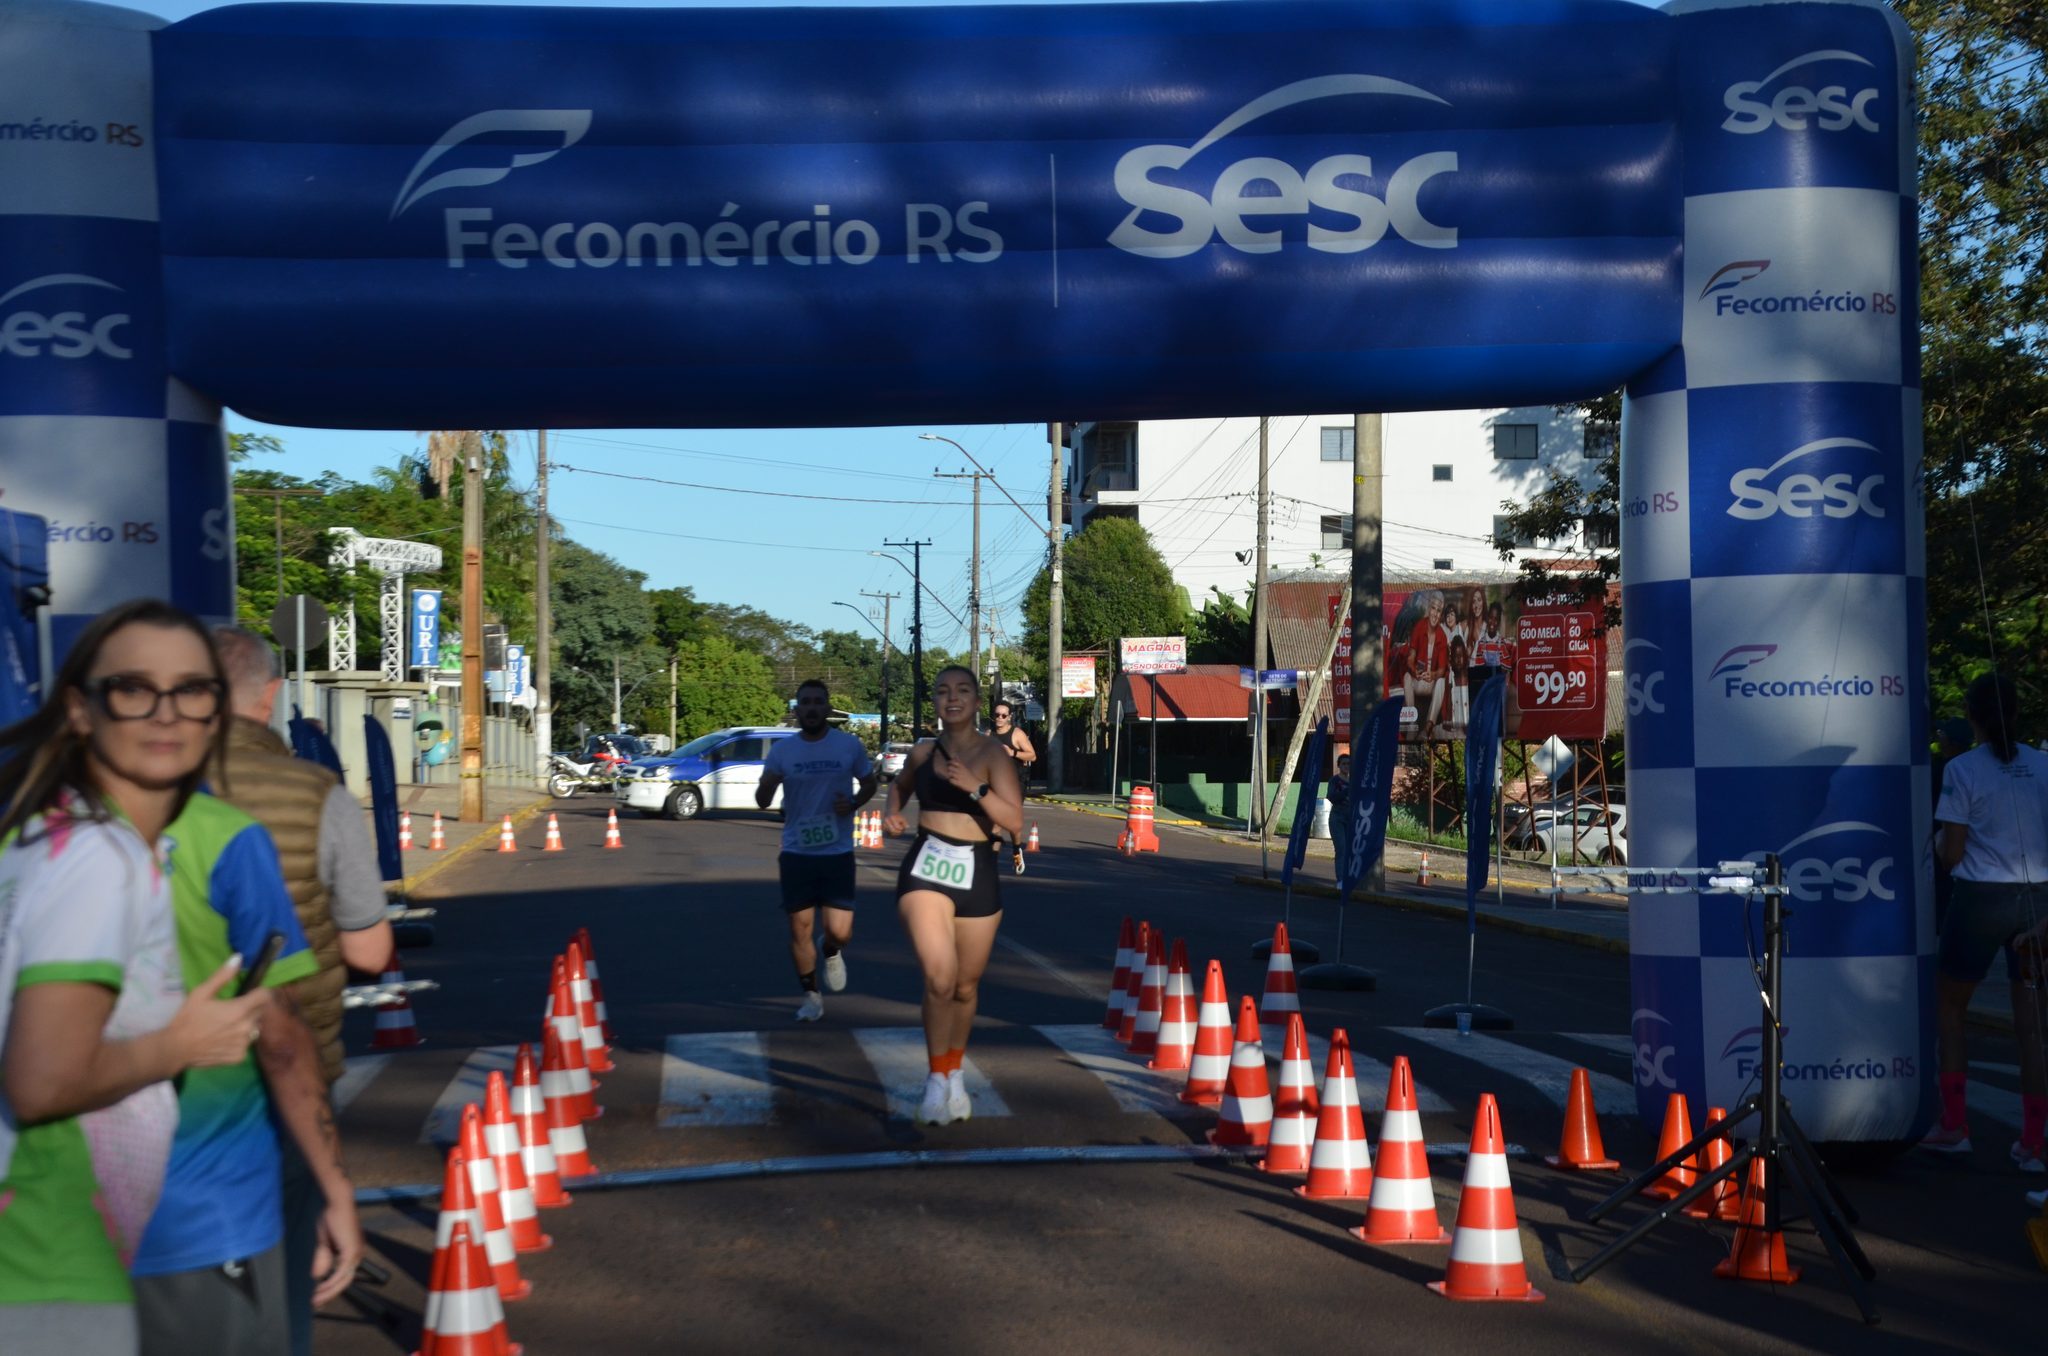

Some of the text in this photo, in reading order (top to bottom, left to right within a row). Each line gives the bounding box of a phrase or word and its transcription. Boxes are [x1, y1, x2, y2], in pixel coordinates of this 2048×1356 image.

[105, 122, 144, 148] RS
[1107, 143, 1459, 259] Sesc
[444, 201, 1004, 268] Fecomércio RS
[1716, 289, 1897, 316] Fecomércio RS
[0, 310, 133, 359] esc
[1653, 491, 1679, 514] RS
[1726, 467, 1886, 521] Sesc
[46, 520, 159, 544] ércio RS
[417, 615, 435, 664] URI
[1520, 627, 1561, 640] 600 MEGA
[1569, 625, 1581, 638] 60
[1334, 642, 1351, 658] Clar
[1568, 639, 1590, 651] GIGA
[1725, 674, 1905, 699] Fecomércio RS
[801, 825, 834, 845] 366
[921, 853, 966, 884] 500
[1741, 850, 1895, 902] esc
